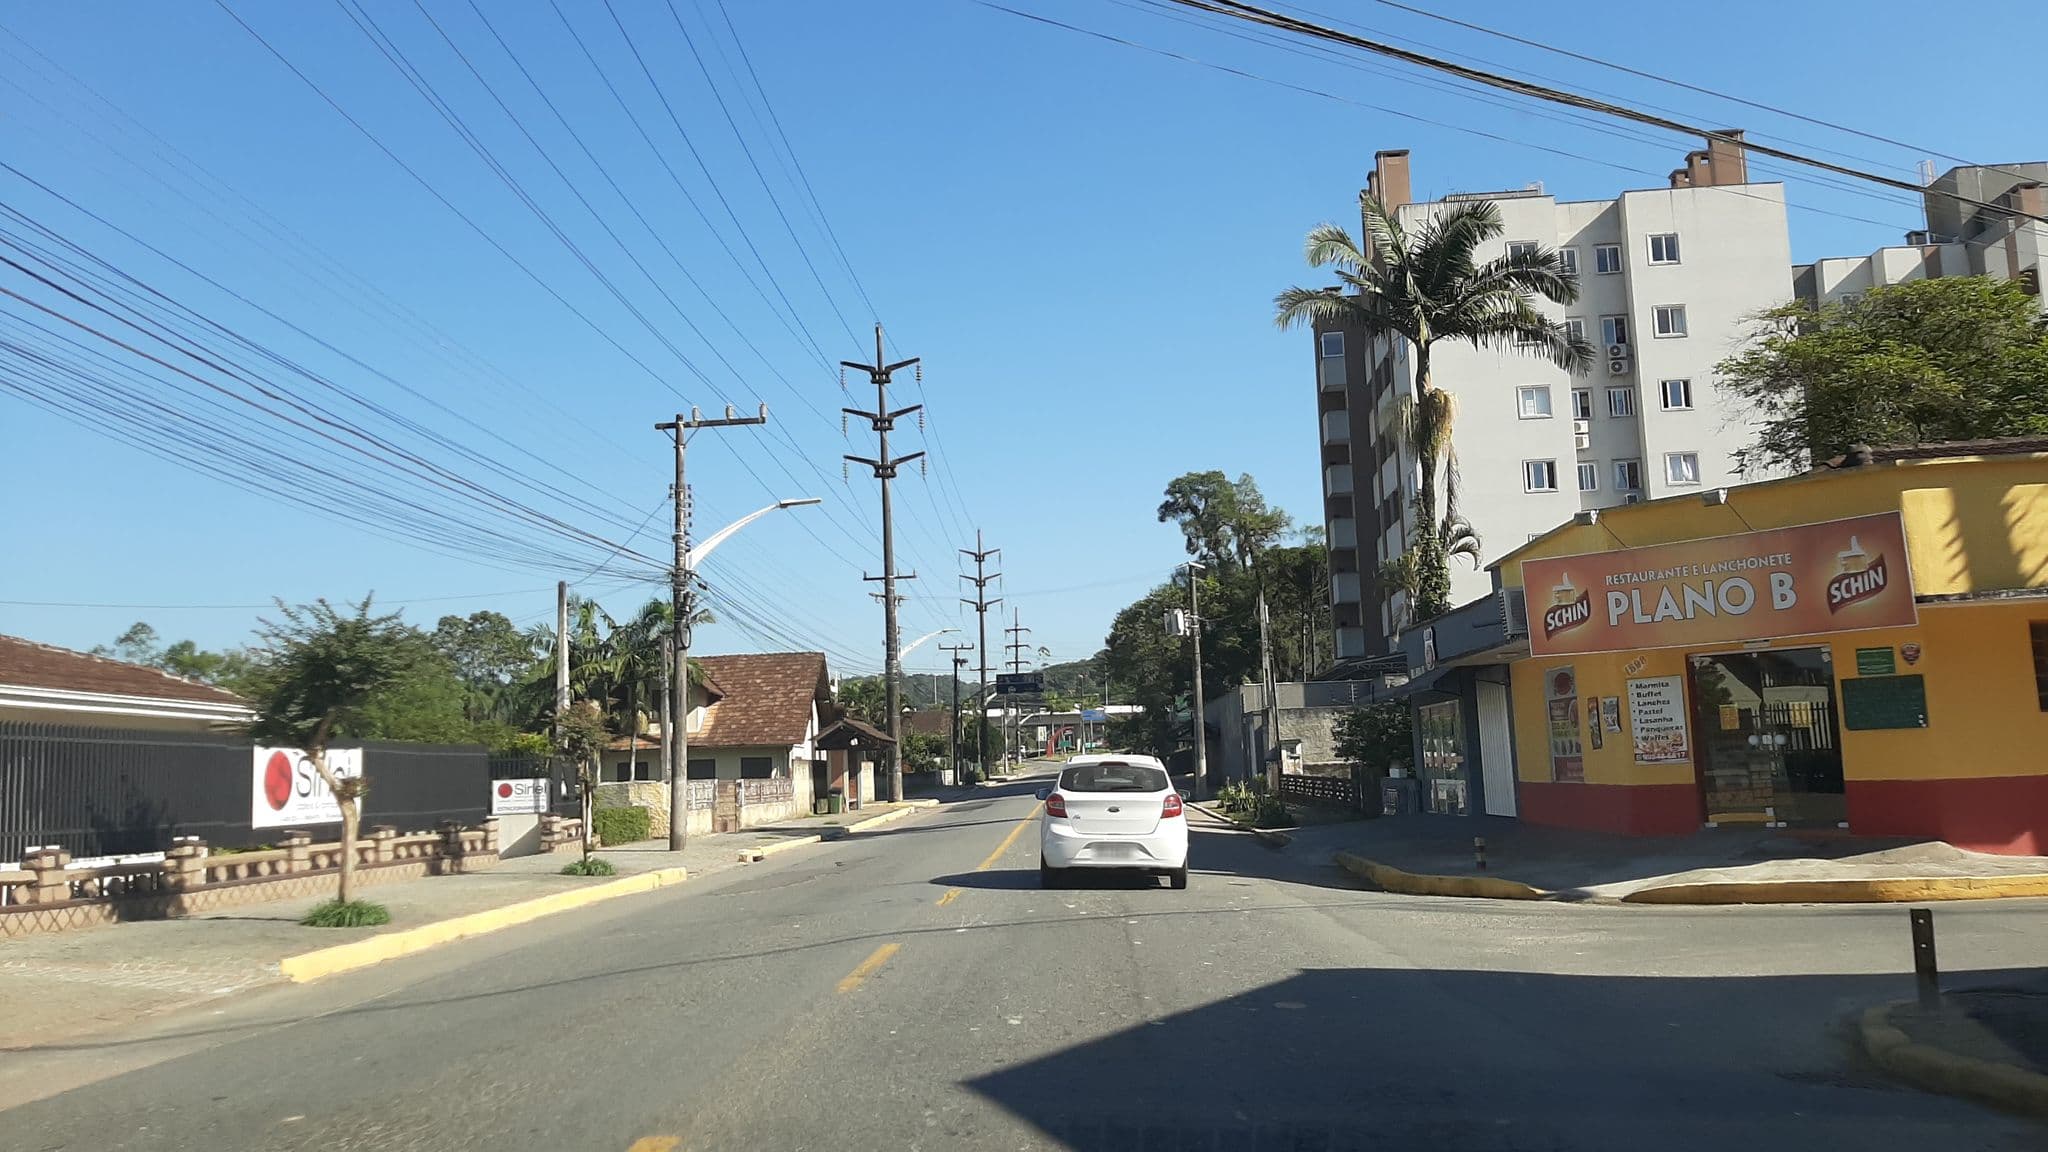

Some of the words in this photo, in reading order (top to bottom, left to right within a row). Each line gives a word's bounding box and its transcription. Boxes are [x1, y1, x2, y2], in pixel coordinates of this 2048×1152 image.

[1605, 566, 1689, 586] RESTAURANTE
[1692, 564, 1700, 577] E
[1702, 553, 1793, 576] LANCHONETE
[1830, 566, 1885, 604] SCHIN
[1546, 599, 1589, 632] SCHIN
[1607, 576, 1756, 626] PLANO
[1770, 572, 1798, 610] B
